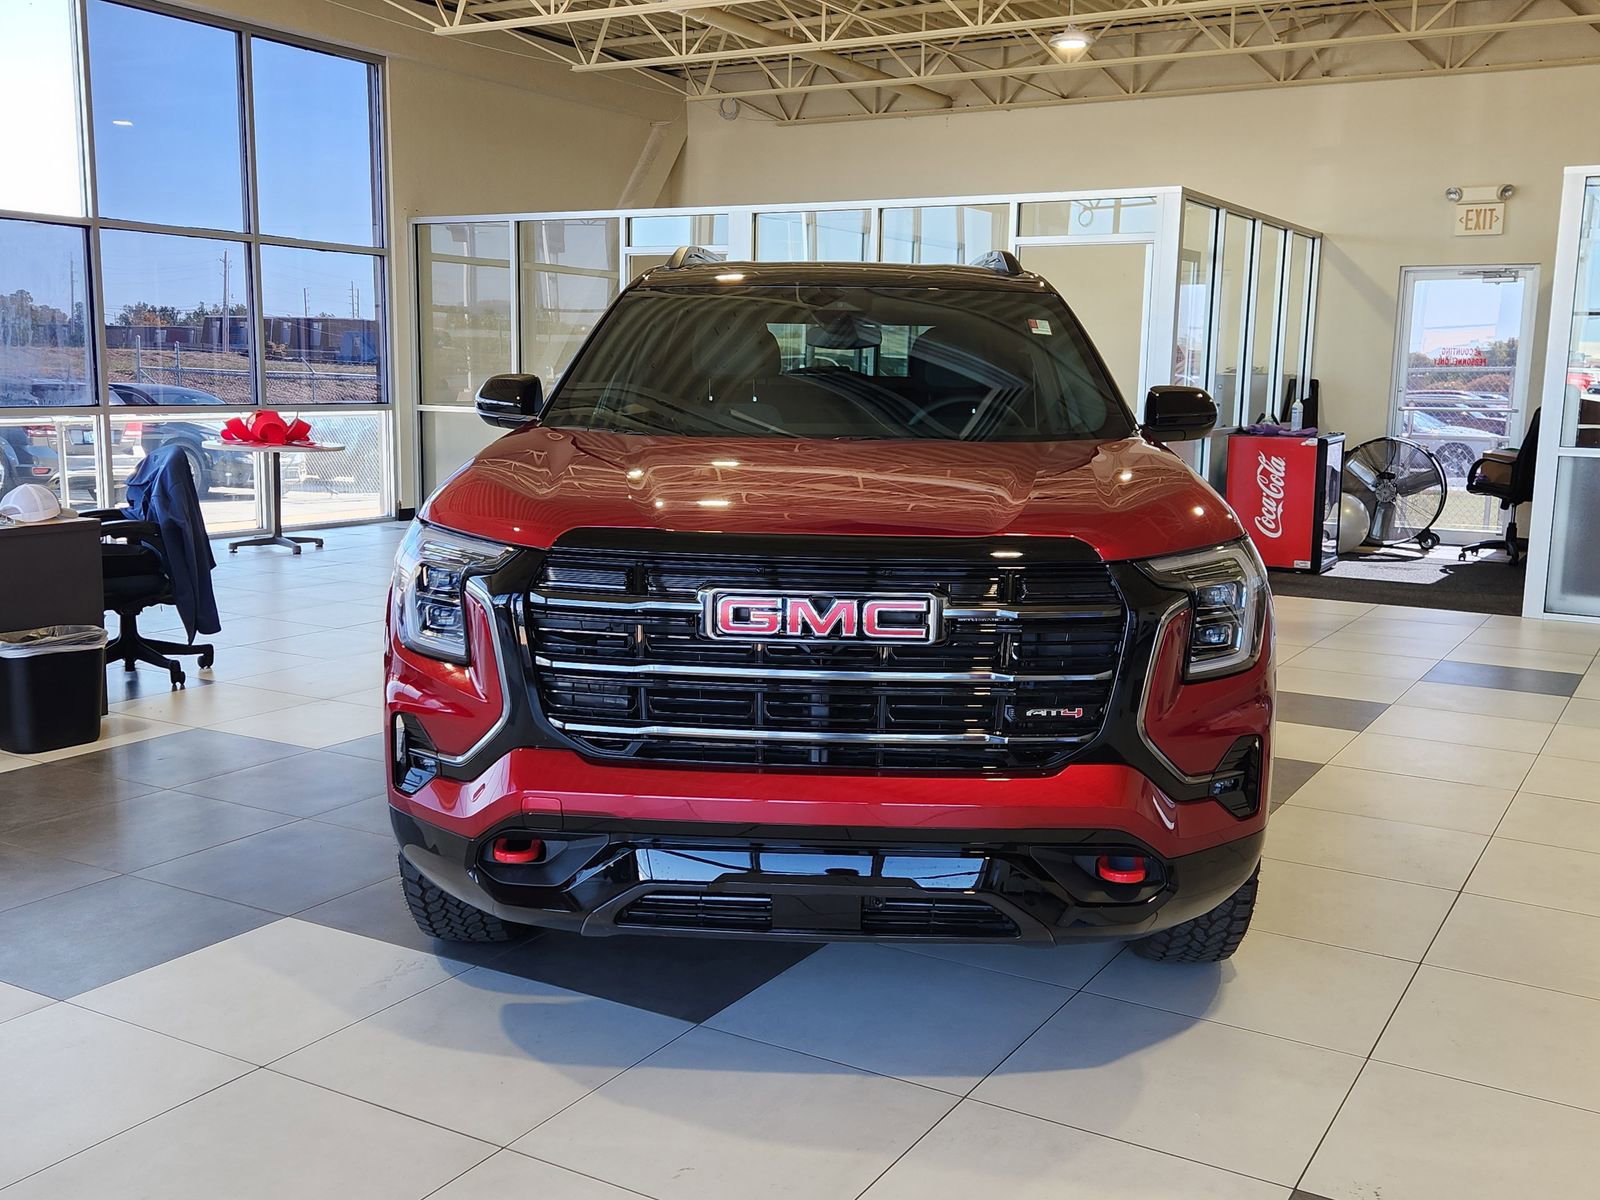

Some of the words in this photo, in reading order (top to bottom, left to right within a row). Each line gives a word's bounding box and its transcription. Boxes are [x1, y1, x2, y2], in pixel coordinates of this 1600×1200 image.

[1464, 208, 1496, 231] EXIT
[716, 597, 928, 638] GMC
[1026, 707, 1083, 719] AT4
